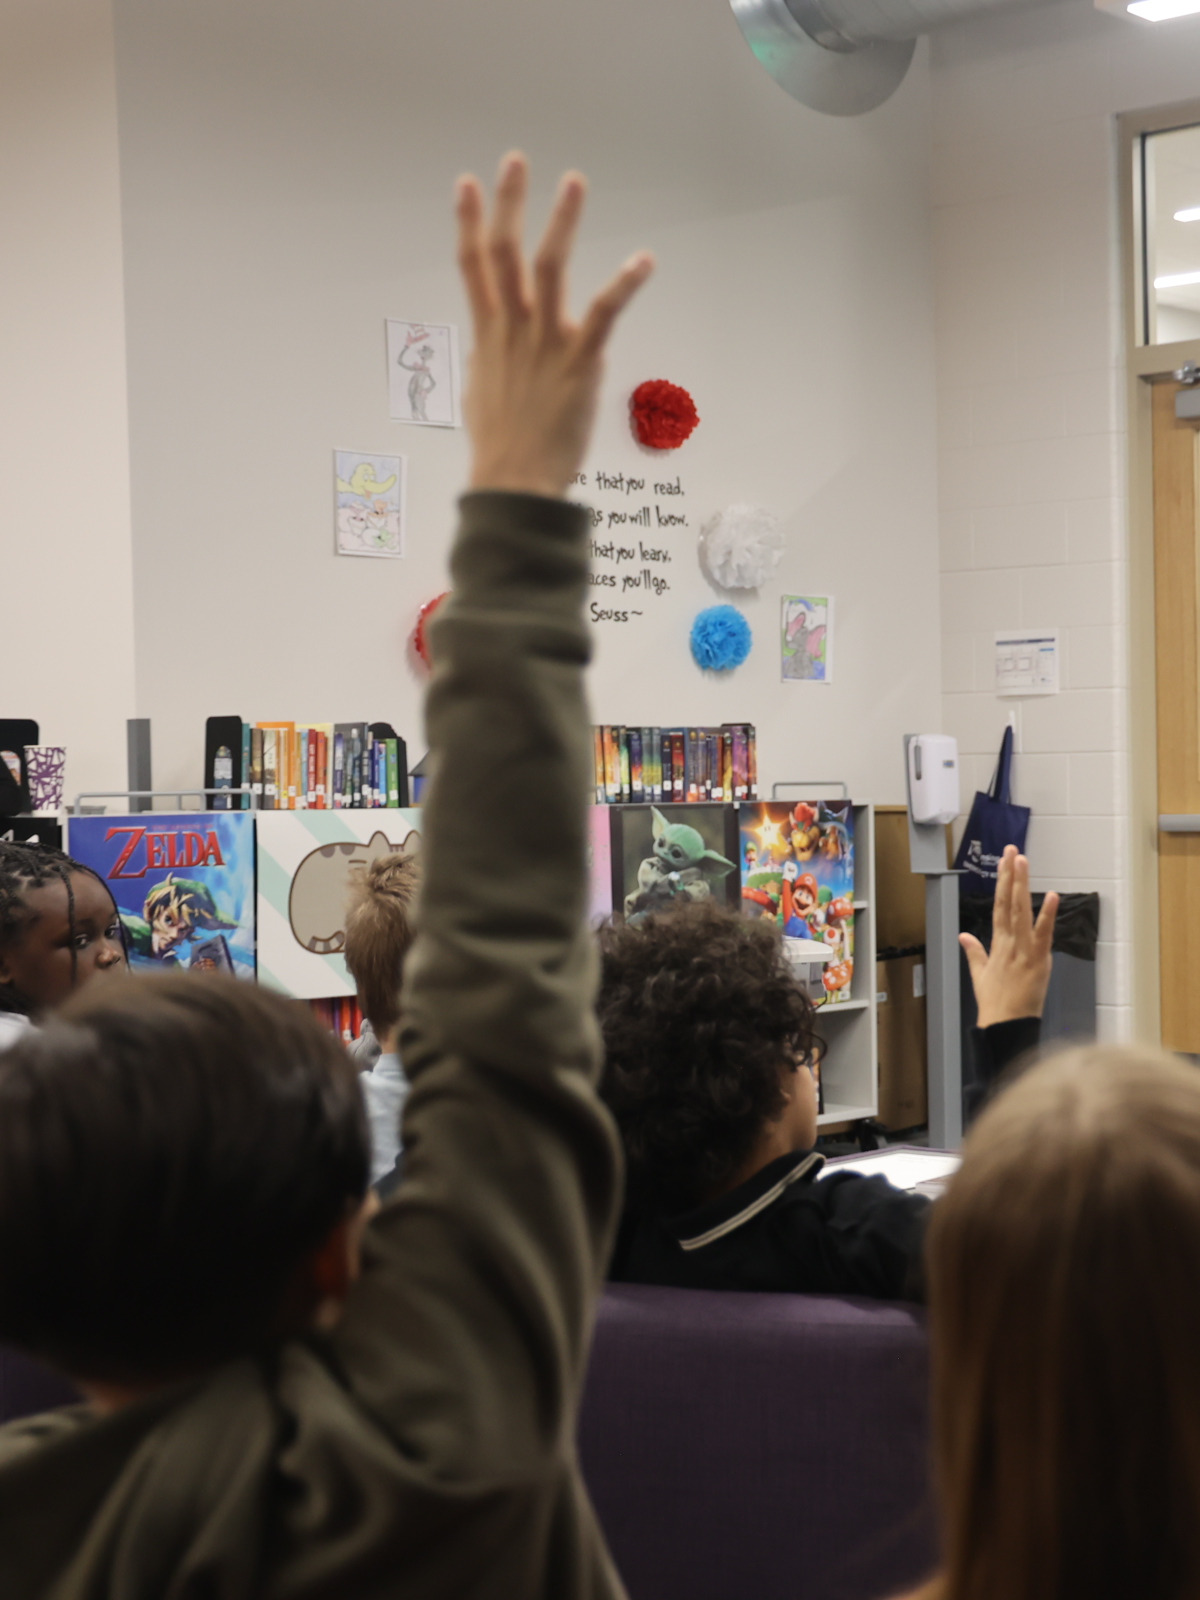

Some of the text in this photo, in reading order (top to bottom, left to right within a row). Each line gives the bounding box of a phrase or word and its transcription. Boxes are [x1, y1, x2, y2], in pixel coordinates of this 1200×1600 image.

[596, 471, 624, 491] that
[626, 478, 645, 496] you
[608, 511, 627, 529] you
[629, 507, 651, 527] will
[616, 548, 635, 565] you
[622, 569, 651, 593] you'll
[104, 825, 227, 879] ZELDA
